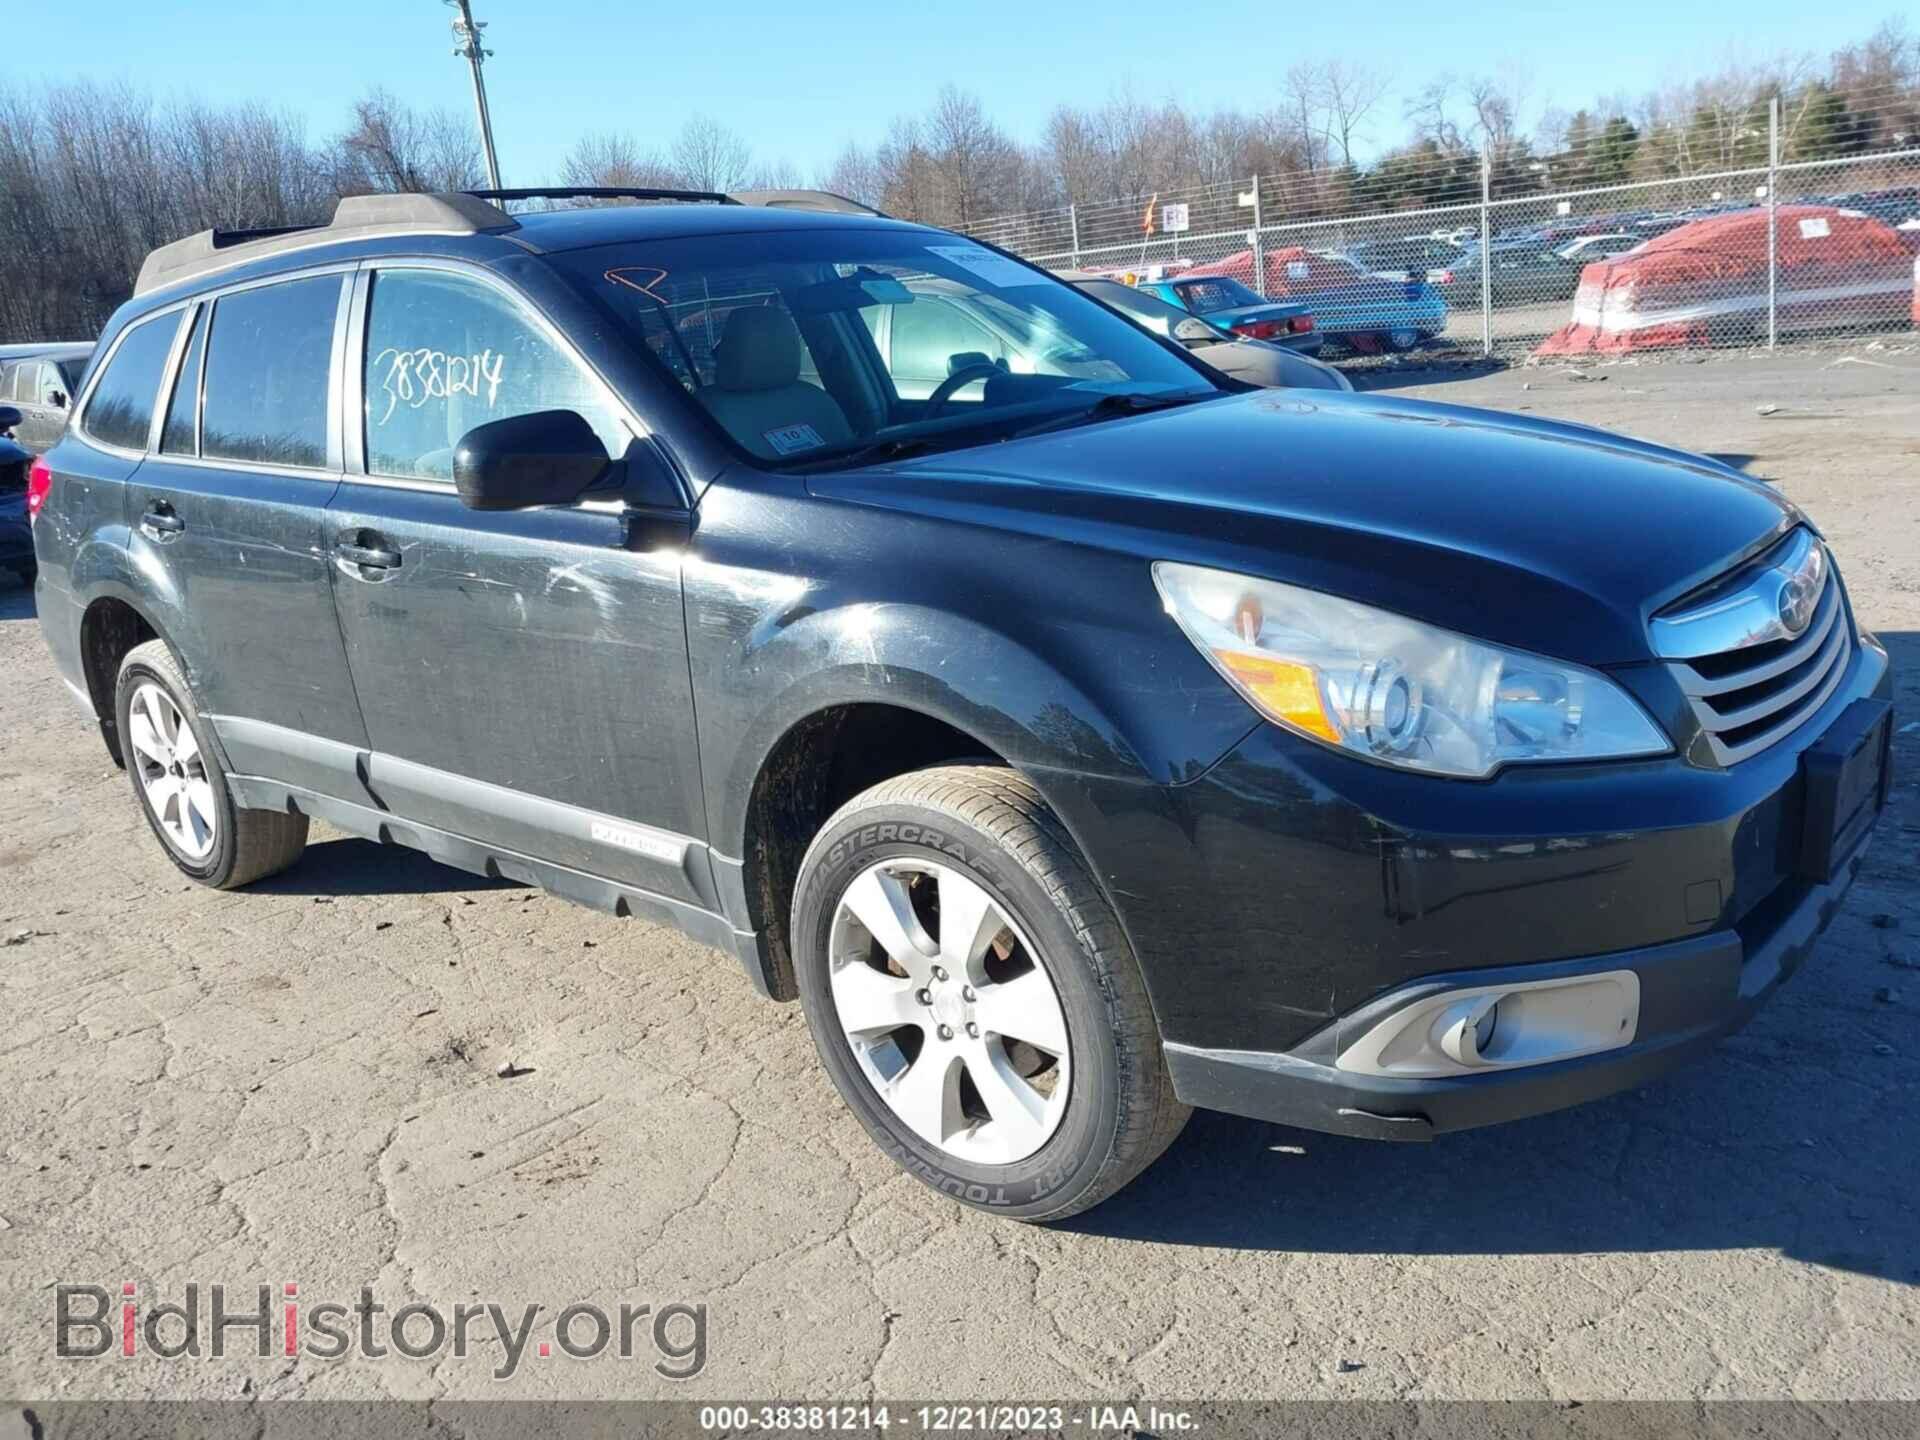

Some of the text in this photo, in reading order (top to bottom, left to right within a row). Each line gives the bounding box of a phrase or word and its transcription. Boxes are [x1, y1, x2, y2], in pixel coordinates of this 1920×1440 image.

[373, 348, 504, 426] 38381214
[806, 822, 1022, 908] MASTERCRAFT
[872, 1125, 1010, 1205] TOURING
